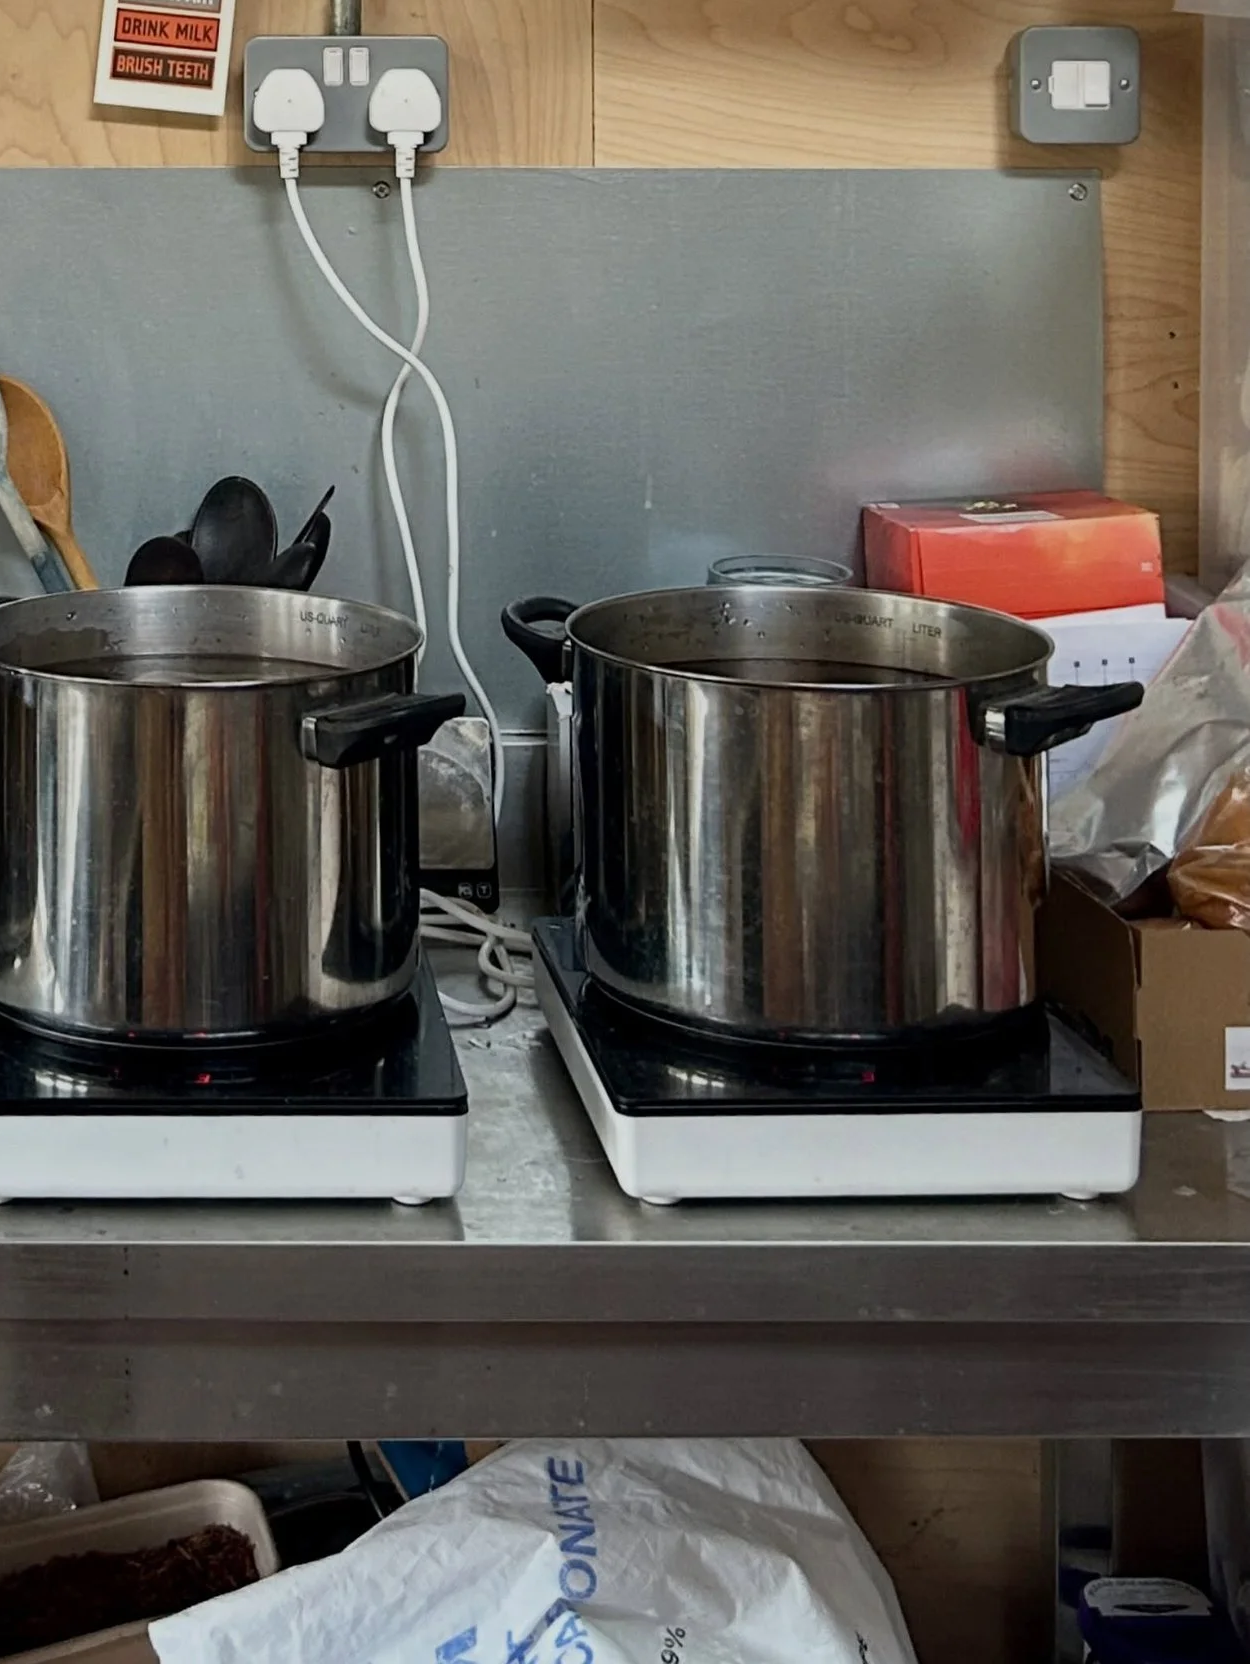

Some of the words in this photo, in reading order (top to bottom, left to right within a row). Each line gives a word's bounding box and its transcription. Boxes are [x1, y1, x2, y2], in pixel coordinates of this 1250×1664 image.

[121, 16, 170, 40] DRINK
[175, 22, 213, 43] MILK
[116, 54, 163, 77] BRUSH
[167, 59, 210, 81] TEETH
[912, 622, 942, 638] LITER
